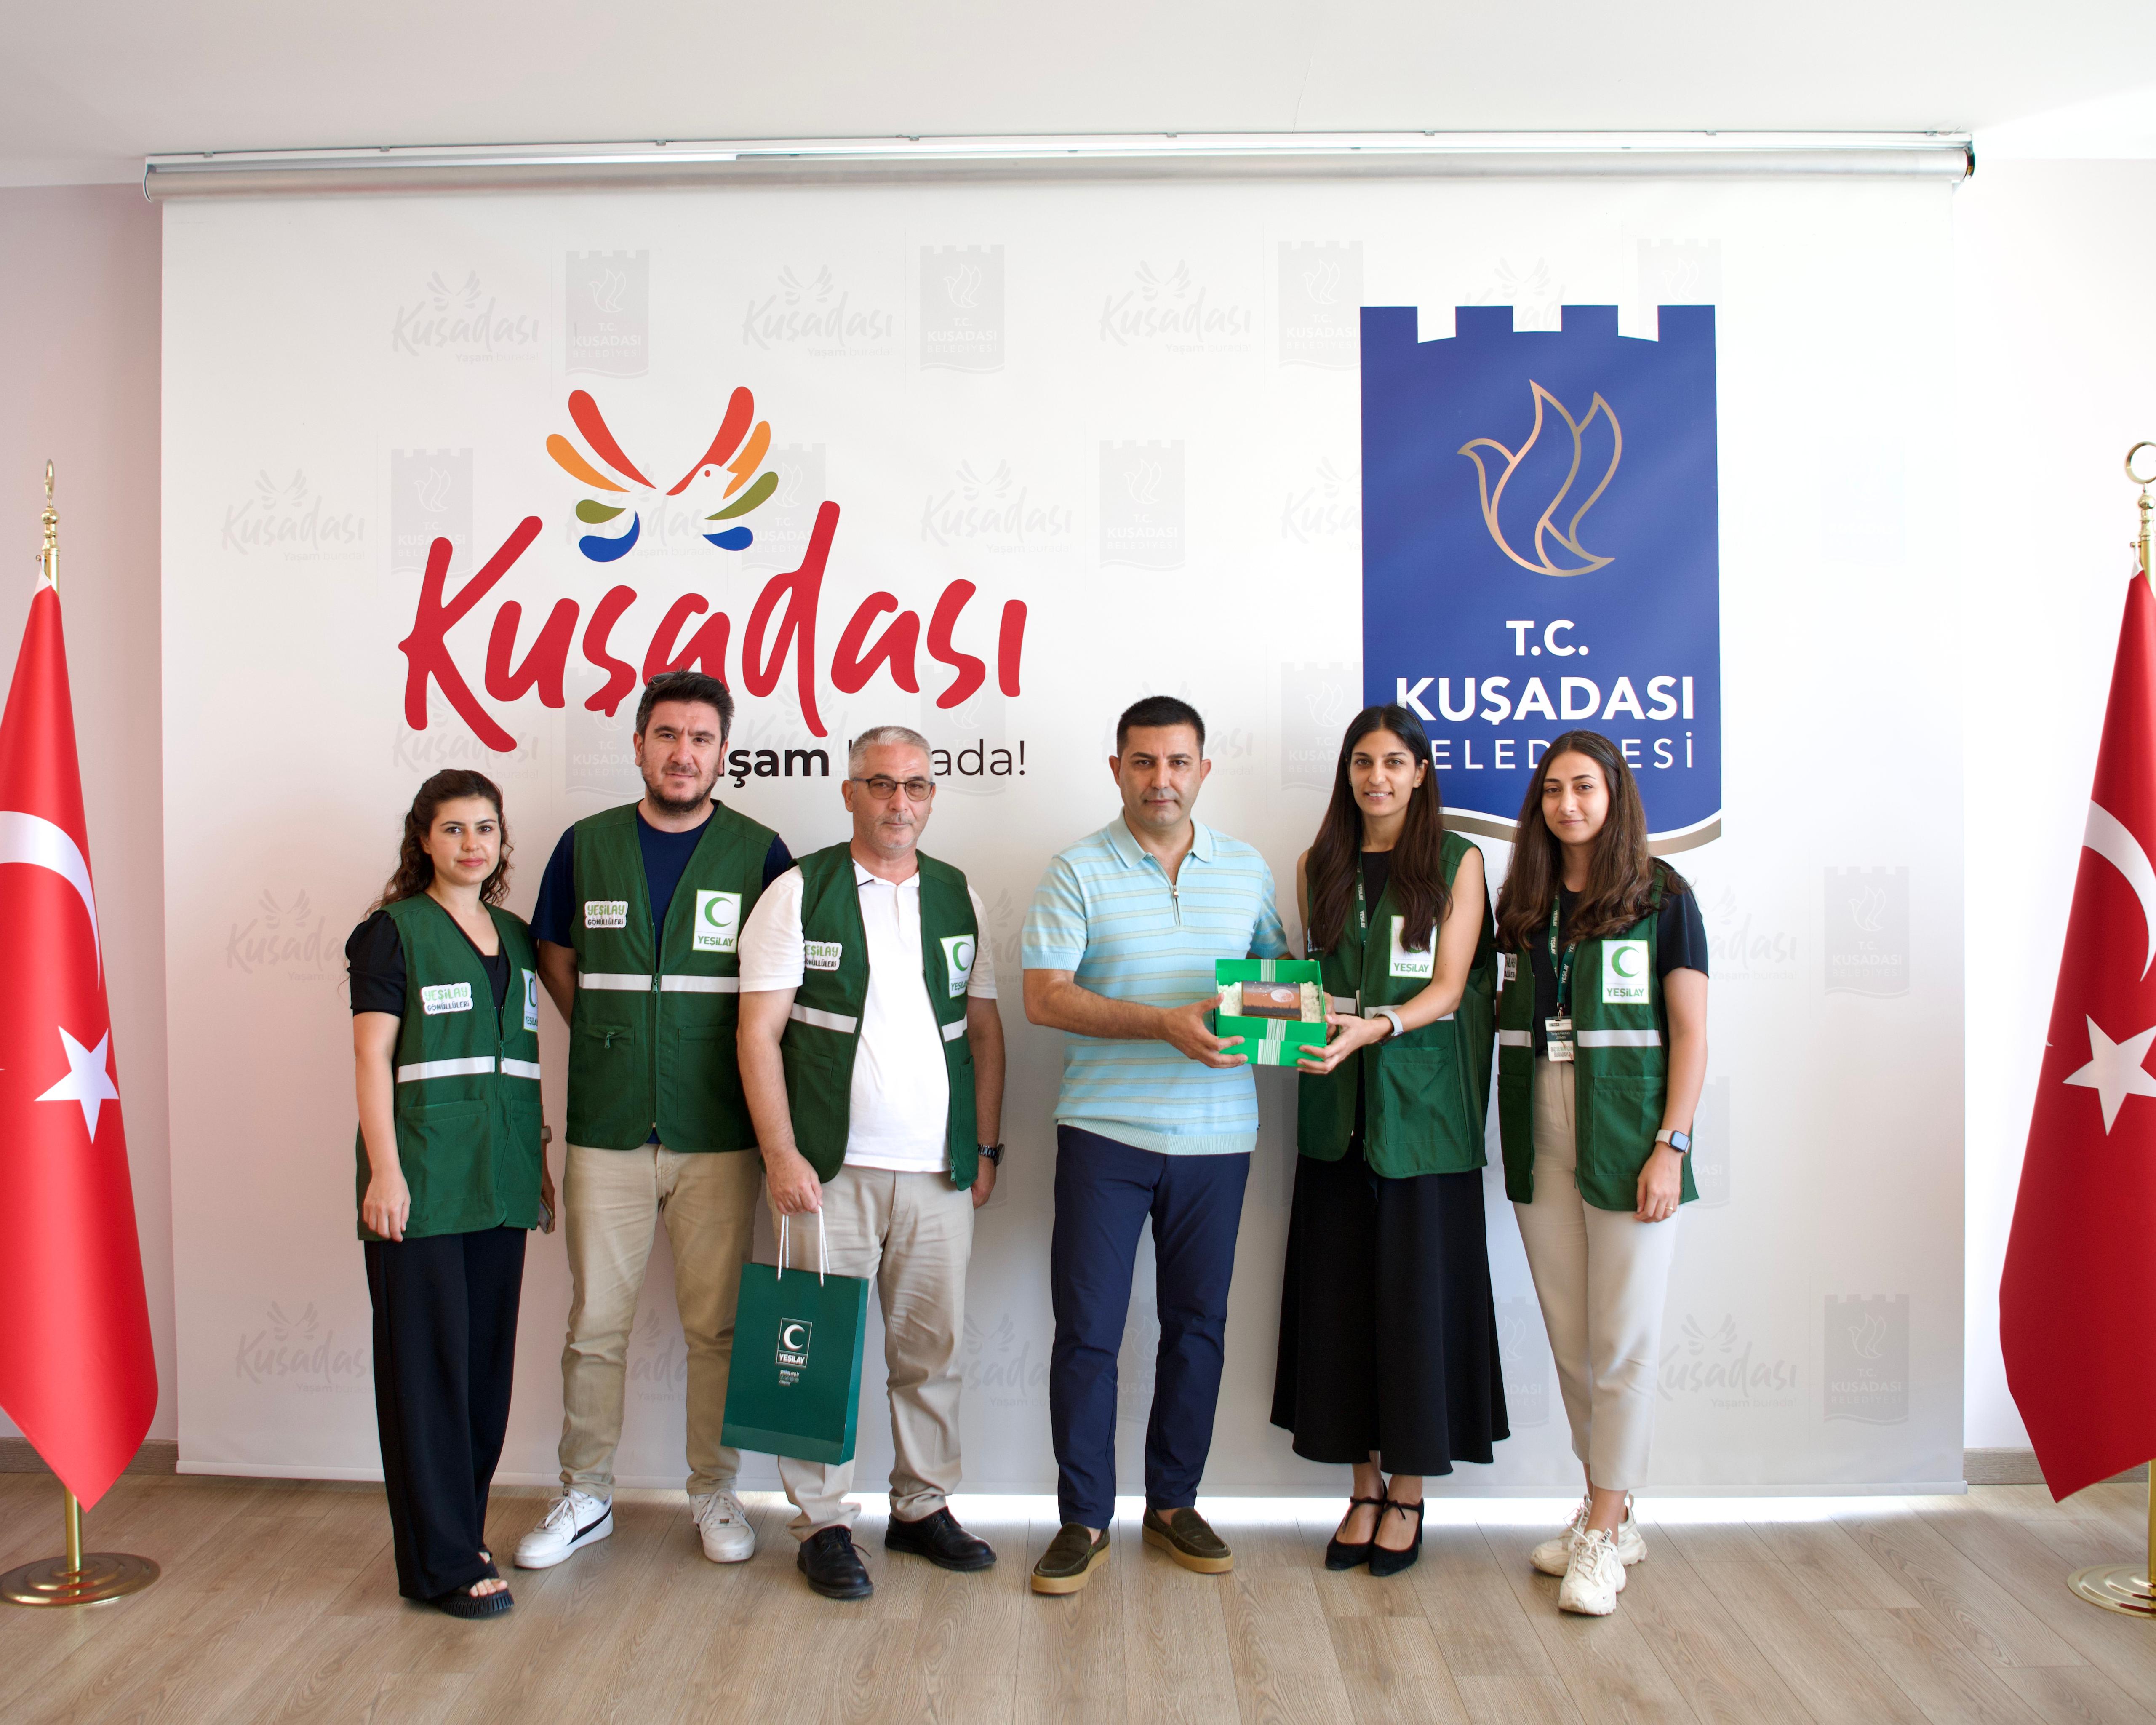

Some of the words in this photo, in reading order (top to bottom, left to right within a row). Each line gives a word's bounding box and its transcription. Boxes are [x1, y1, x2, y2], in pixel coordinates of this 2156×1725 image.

[392, 297, 539, 357] Kuşadası
[742, 291, 893, 350] Kuşadası
[1099, 288, 1251, 346] Kuşadası
[220, 496, 365, 556] Kuşadası
[753, 530, 811, 543] KUŞADAS
[921, 486, 1072, 547] Kuşadası
[1280, 487, 1361, 544] Kuşa
[398, 500, 1028, 753] Kuşadası
[1505, 619, 1589, 657] T.C.
[1396, 675, 1694, 726] KUŞADASI
[392, 713, 539, 773] Kuşadsı
[572, 753, 636, 767] KUŞADAS
[718, 749, 830, 788] şam
[848, 739, 1026, 777] ada!
[1431, 731, 1693, 769] ELEDESİ
[226, 916, 344, 975] Kuşada
[698, 935, 734, 947] YEŞİLAY
[805, 944, 839, 957] EŞİLAY
[806, 958, 837, 967] NÜLLÜLERİ
[1709, 913, 1797, 970] adası
[951, 980, 968, 991] YEŞİLA
[1394, 962, 1430, 973] YEŞİLAY
[1606, 988, 1644, 998] YEŞİLAY
[525, 1015, 538, 1026] YEŞİLA
[235, 1328, 373, 1386] Kuşadas
